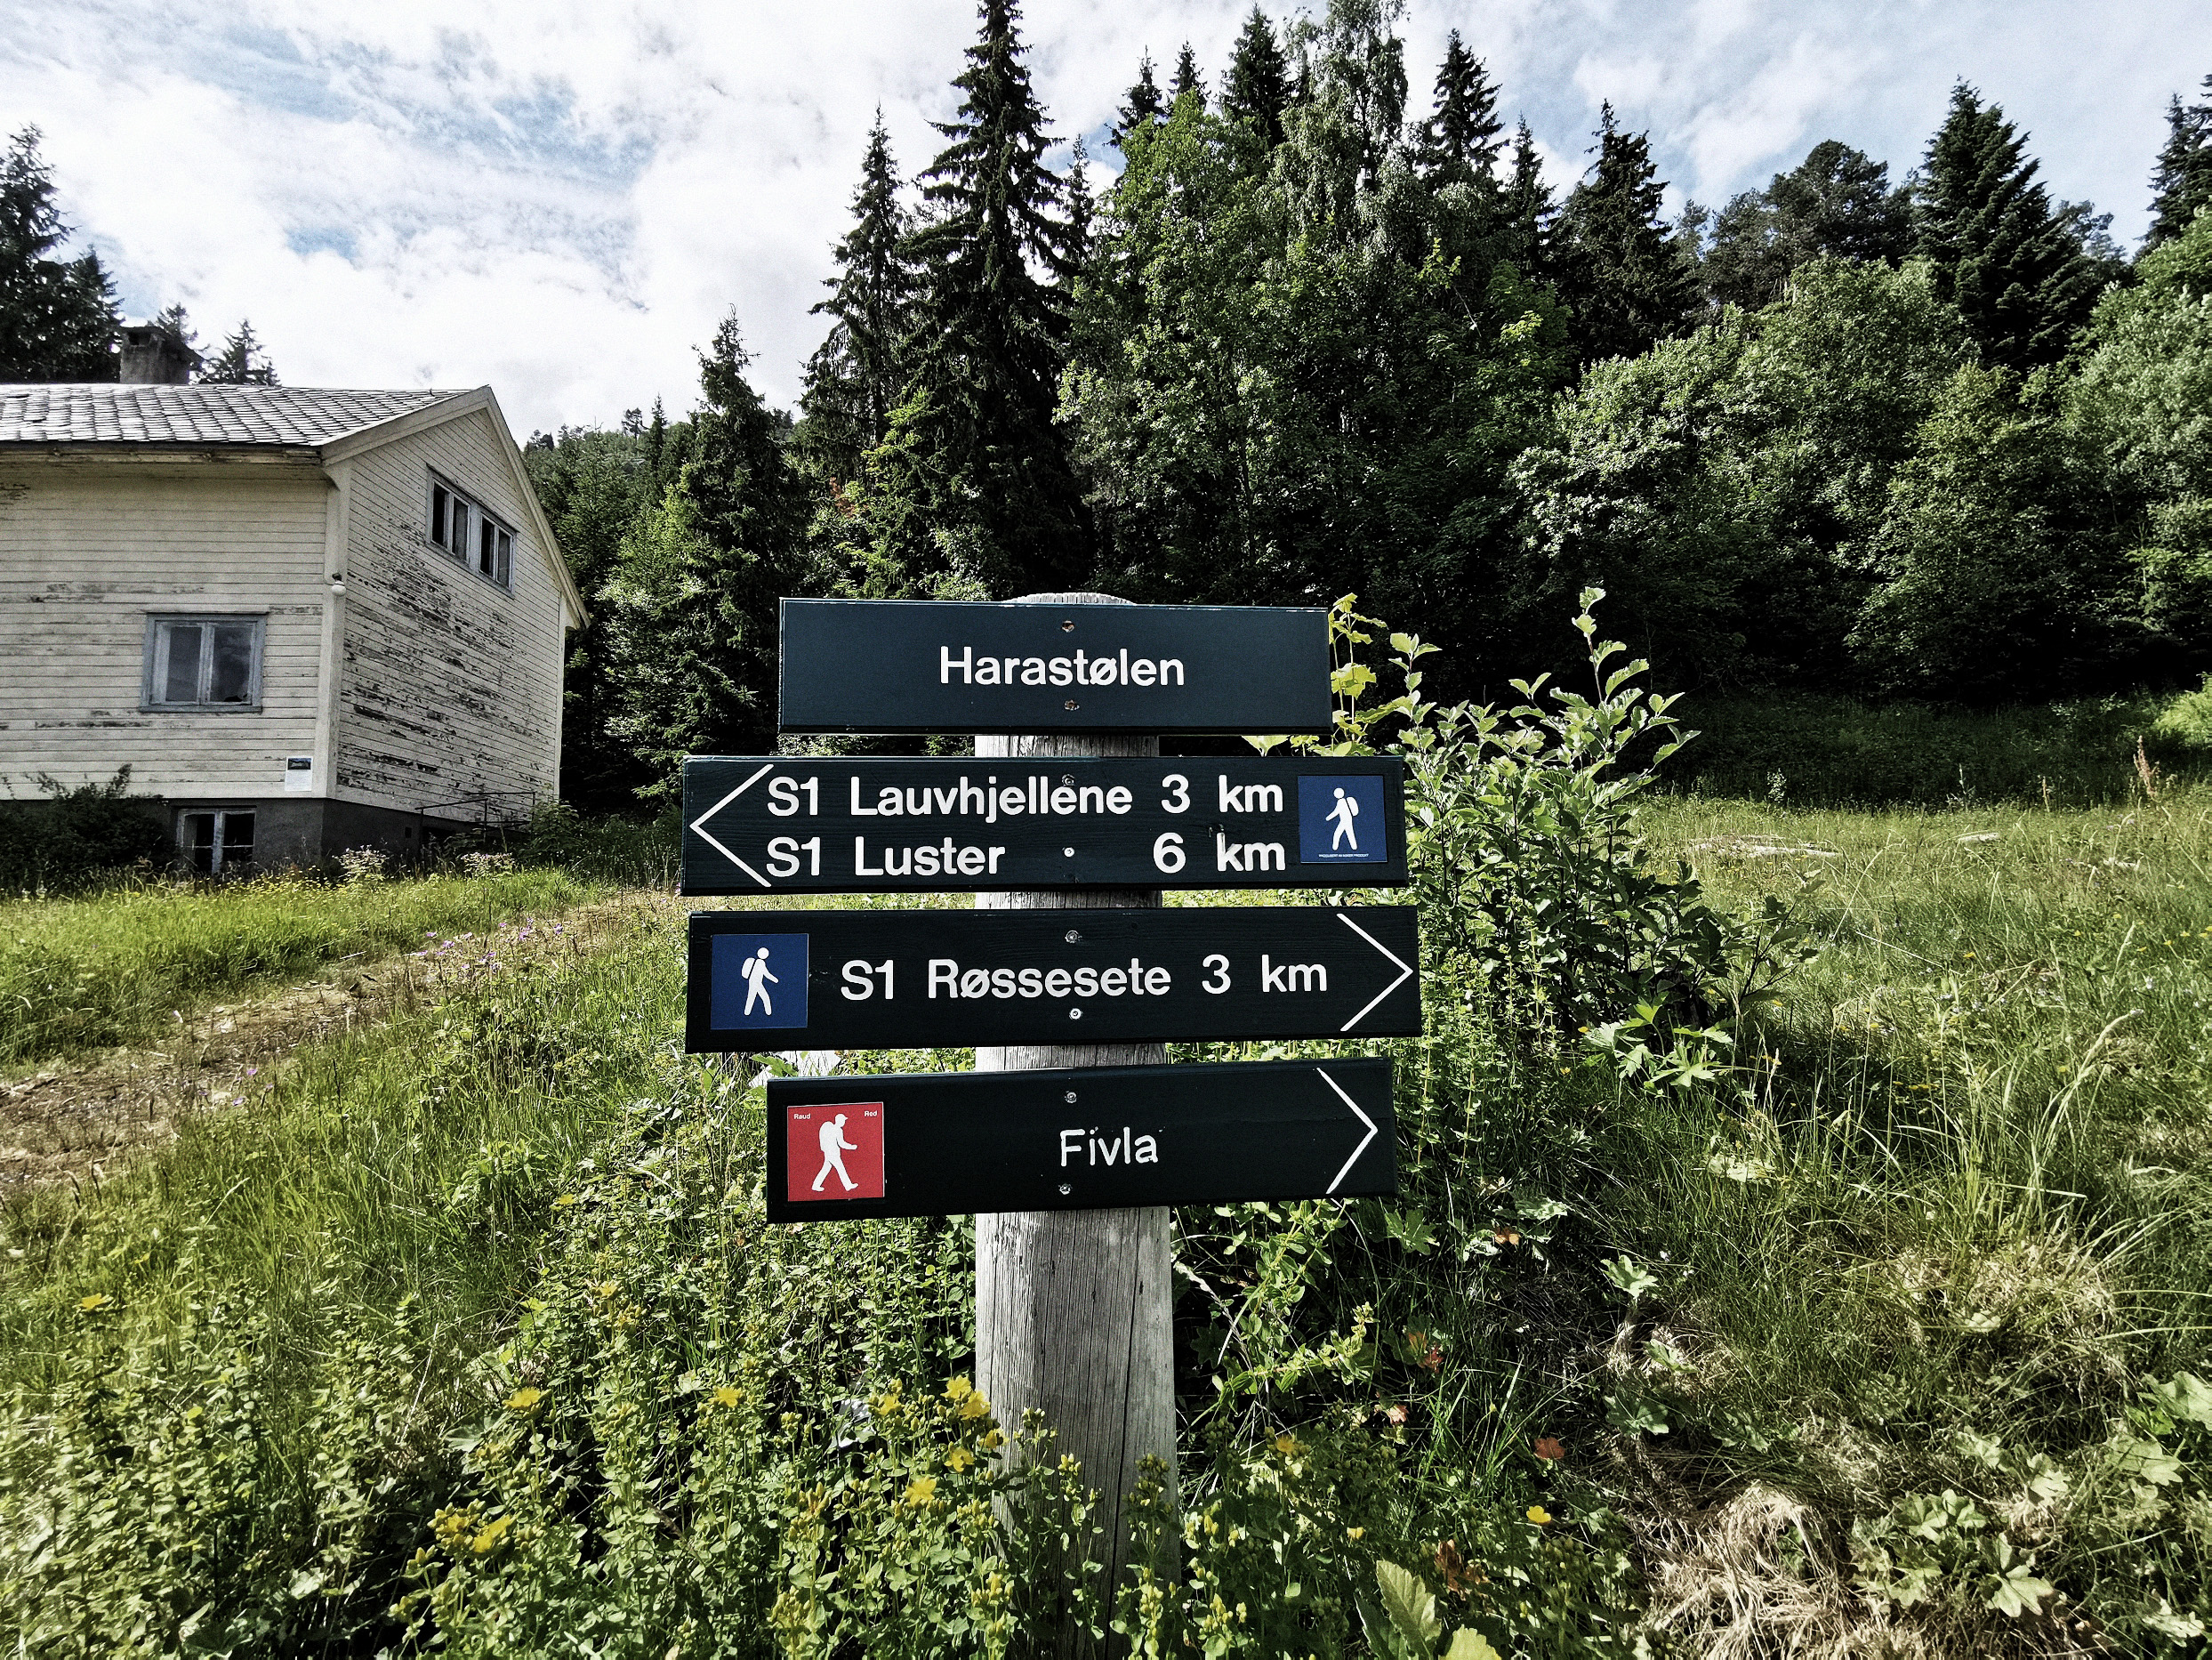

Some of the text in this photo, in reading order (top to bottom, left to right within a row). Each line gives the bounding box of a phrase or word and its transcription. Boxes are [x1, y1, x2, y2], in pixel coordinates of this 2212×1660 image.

[940, 645, 1185, 687] Harastølen
[767, 773, 1283, 824] S1 Lauvhjellene 3 km
[766, 832, 1286, 878] S1 Luster 6 km
[841, 954, 1327, 1001] S1 Røssesete 3 km
[1059, 1126, 1159, 1167] Fivla
